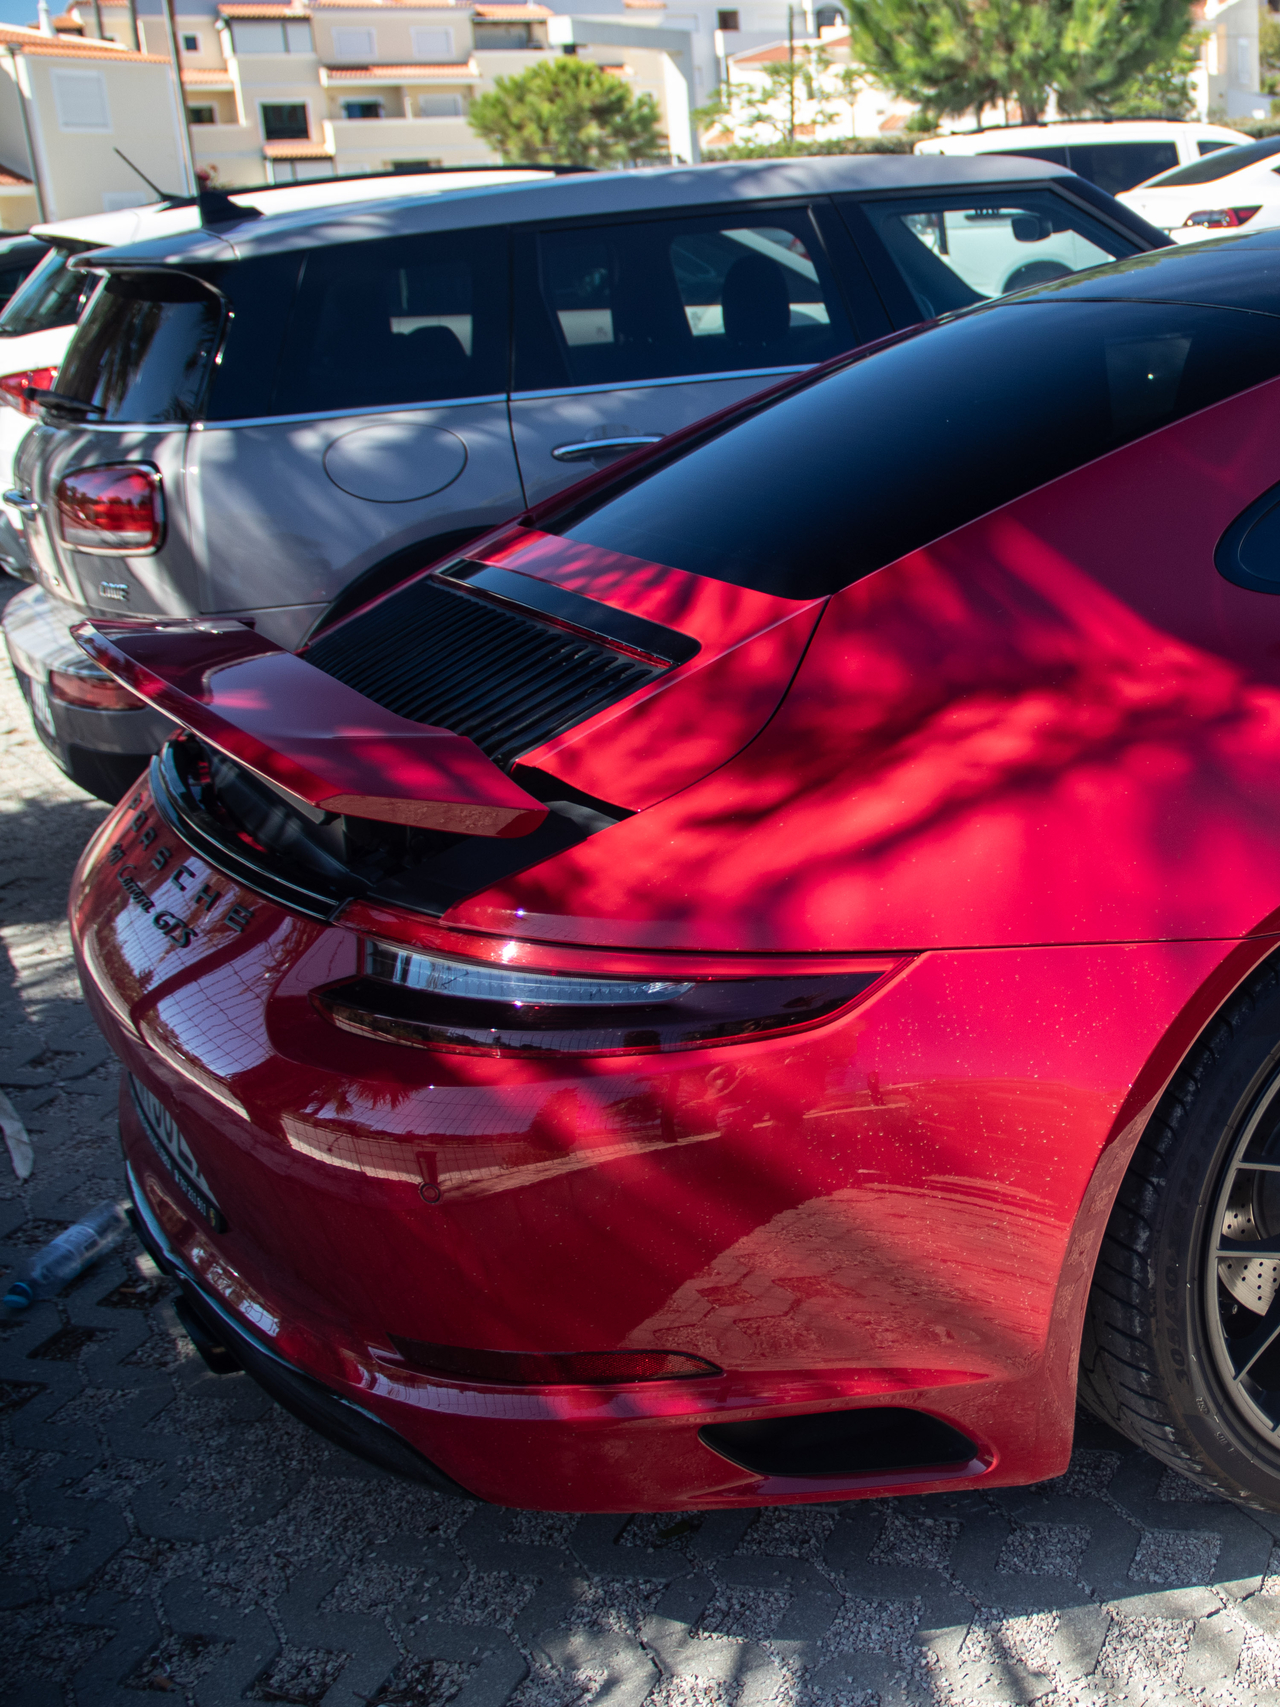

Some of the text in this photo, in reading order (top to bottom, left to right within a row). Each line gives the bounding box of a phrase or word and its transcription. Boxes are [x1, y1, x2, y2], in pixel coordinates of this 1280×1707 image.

[100, 581, 128, 601] ONE
[128, 790, 255, 933] PORSCHE
[116, 863, 156, 914] Carrera
[152, 909, 199, 949] GTS
